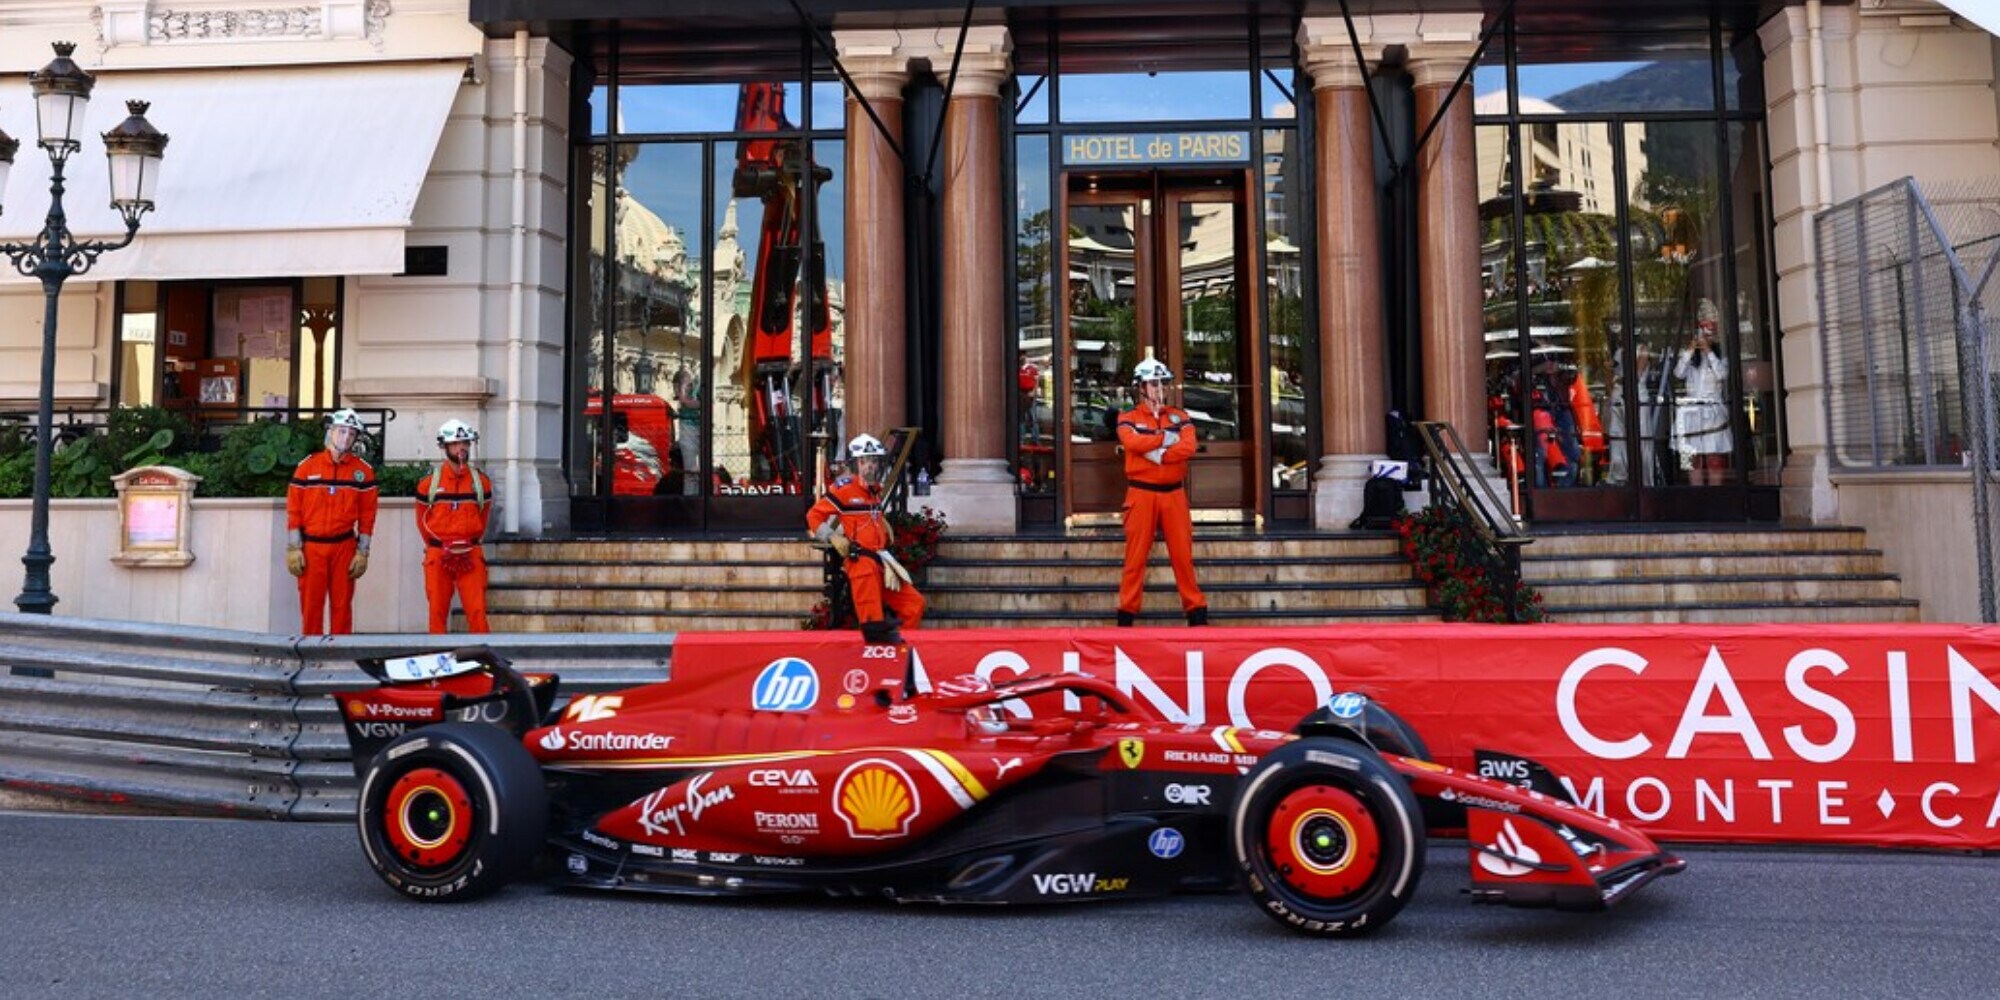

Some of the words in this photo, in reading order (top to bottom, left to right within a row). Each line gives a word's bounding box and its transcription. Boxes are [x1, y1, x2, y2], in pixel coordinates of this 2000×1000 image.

[1071, 138, 1142, 160] HOTEL
[1148, 137, 1173, 158] de
[1179, 135, 1241, 158] PARIS
[862, 645, 896, 659] ZCG
[759, 659, 812, 710] hp
[366, 703, 434, 717] V-Power
[355, 721, 406, 738] VGW
[569, 731, 675, 750] Santander
[1164, 750, 1230, 765] RICHARD
[1479, 759, 1530, 778] aws
[1455, 791, 1523, 814] Santander
[1559, 776, 1851, 826] MONTE
[1920, 781, 2000, 829] C
[754, 811, 819, 828] PERONI
[1152, 828, 1180, 858] hp
[1032, 872, 1097, 895] VGW
[1094, 877, 1130, 893] PLAY
